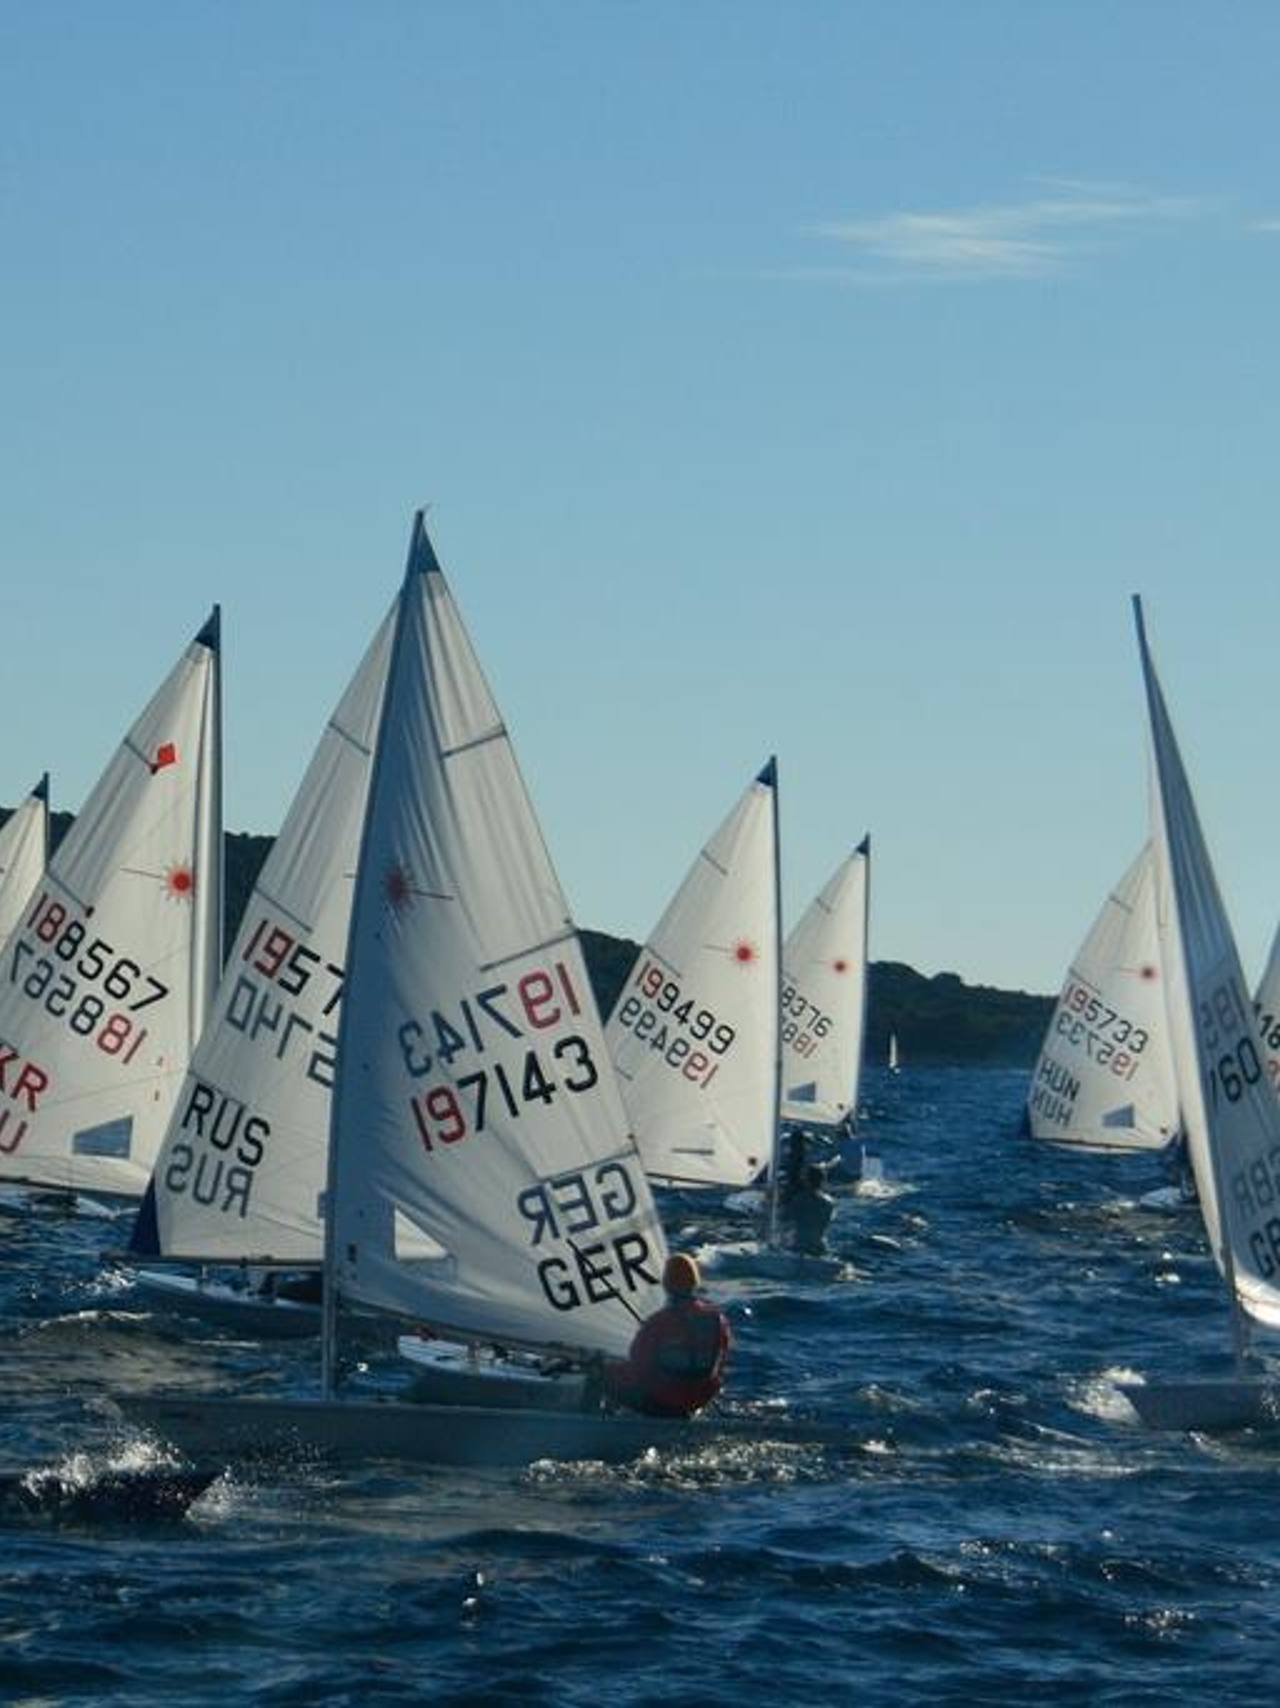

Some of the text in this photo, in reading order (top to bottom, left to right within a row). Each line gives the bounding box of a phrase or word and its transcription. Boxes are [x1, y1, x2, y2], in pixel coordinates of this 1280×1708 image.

[27, 893, 168, 1012] 188567
[635, 960, 736, 1055] 199499
[1063, 983, 1149, 1054] 195733
[181, 1083, 271, 1168] RUS
[409, 1034, 599, 1152] 197143
[537, 1231, 659, 1312] GER
